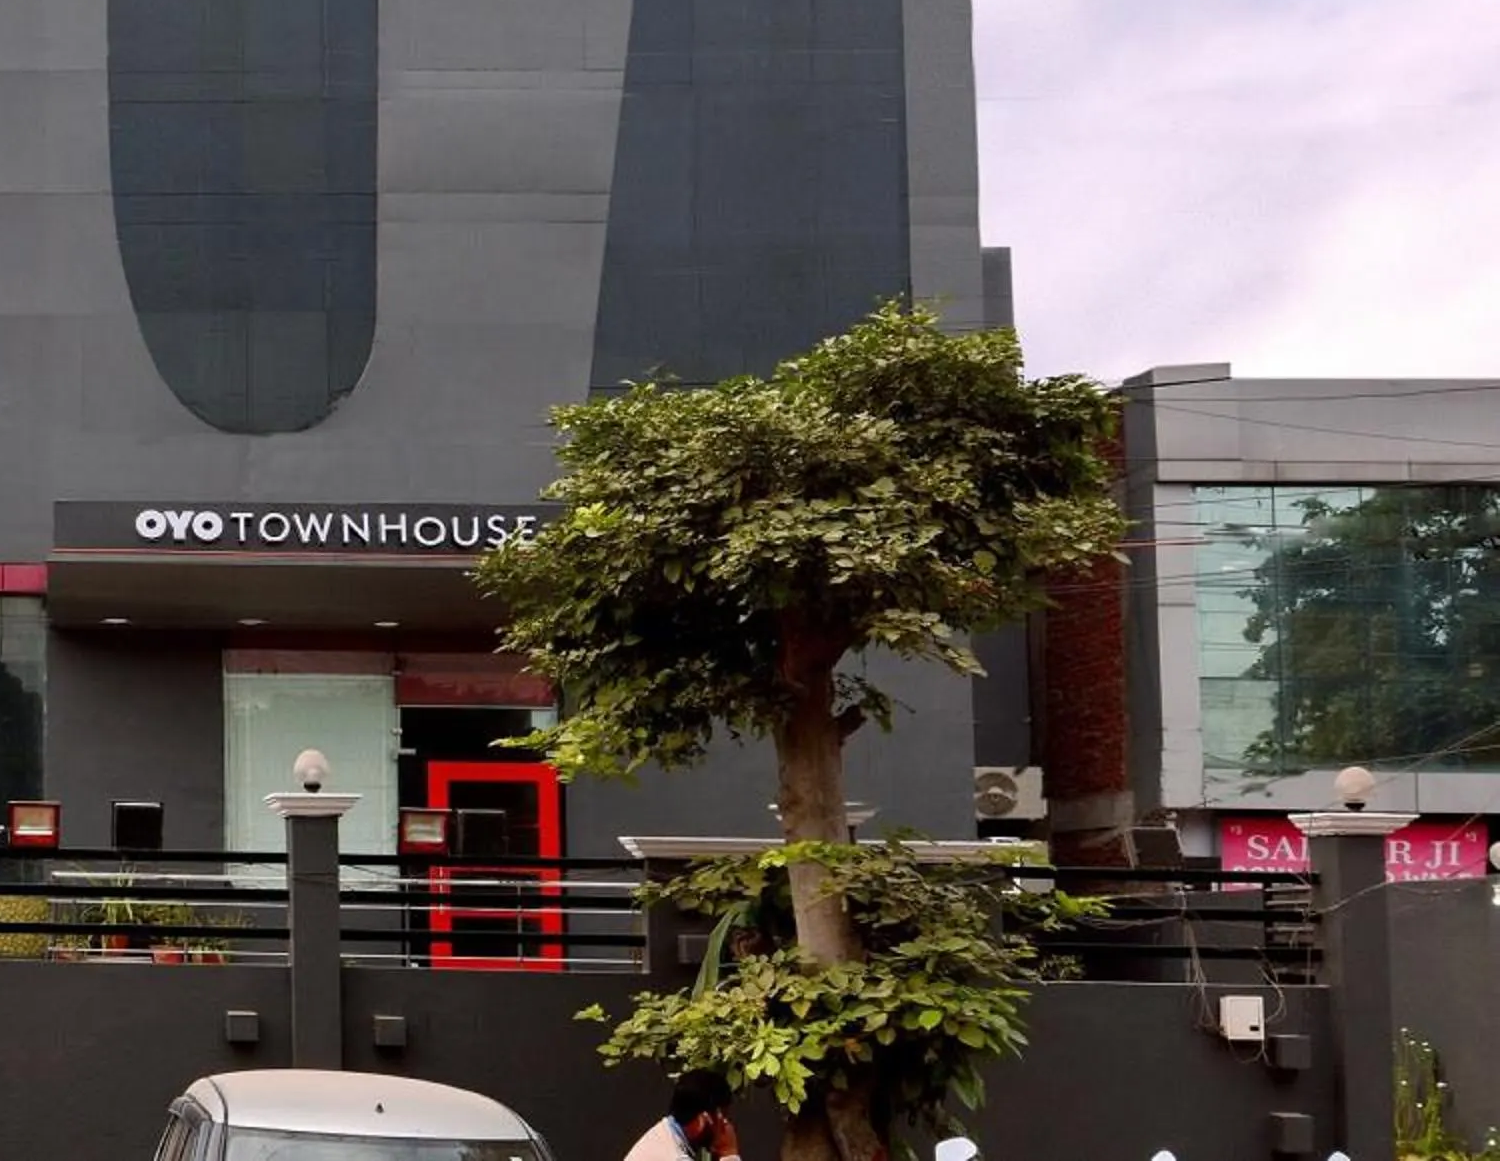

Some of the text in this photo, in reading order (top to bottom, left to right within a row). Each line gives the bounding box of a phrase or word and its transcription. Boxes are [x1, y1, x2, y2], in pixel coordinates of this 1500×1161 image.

[135, 509, 537, 546] OYO TOWNHOUSE
[1424, 840, 1461, 869] JI
